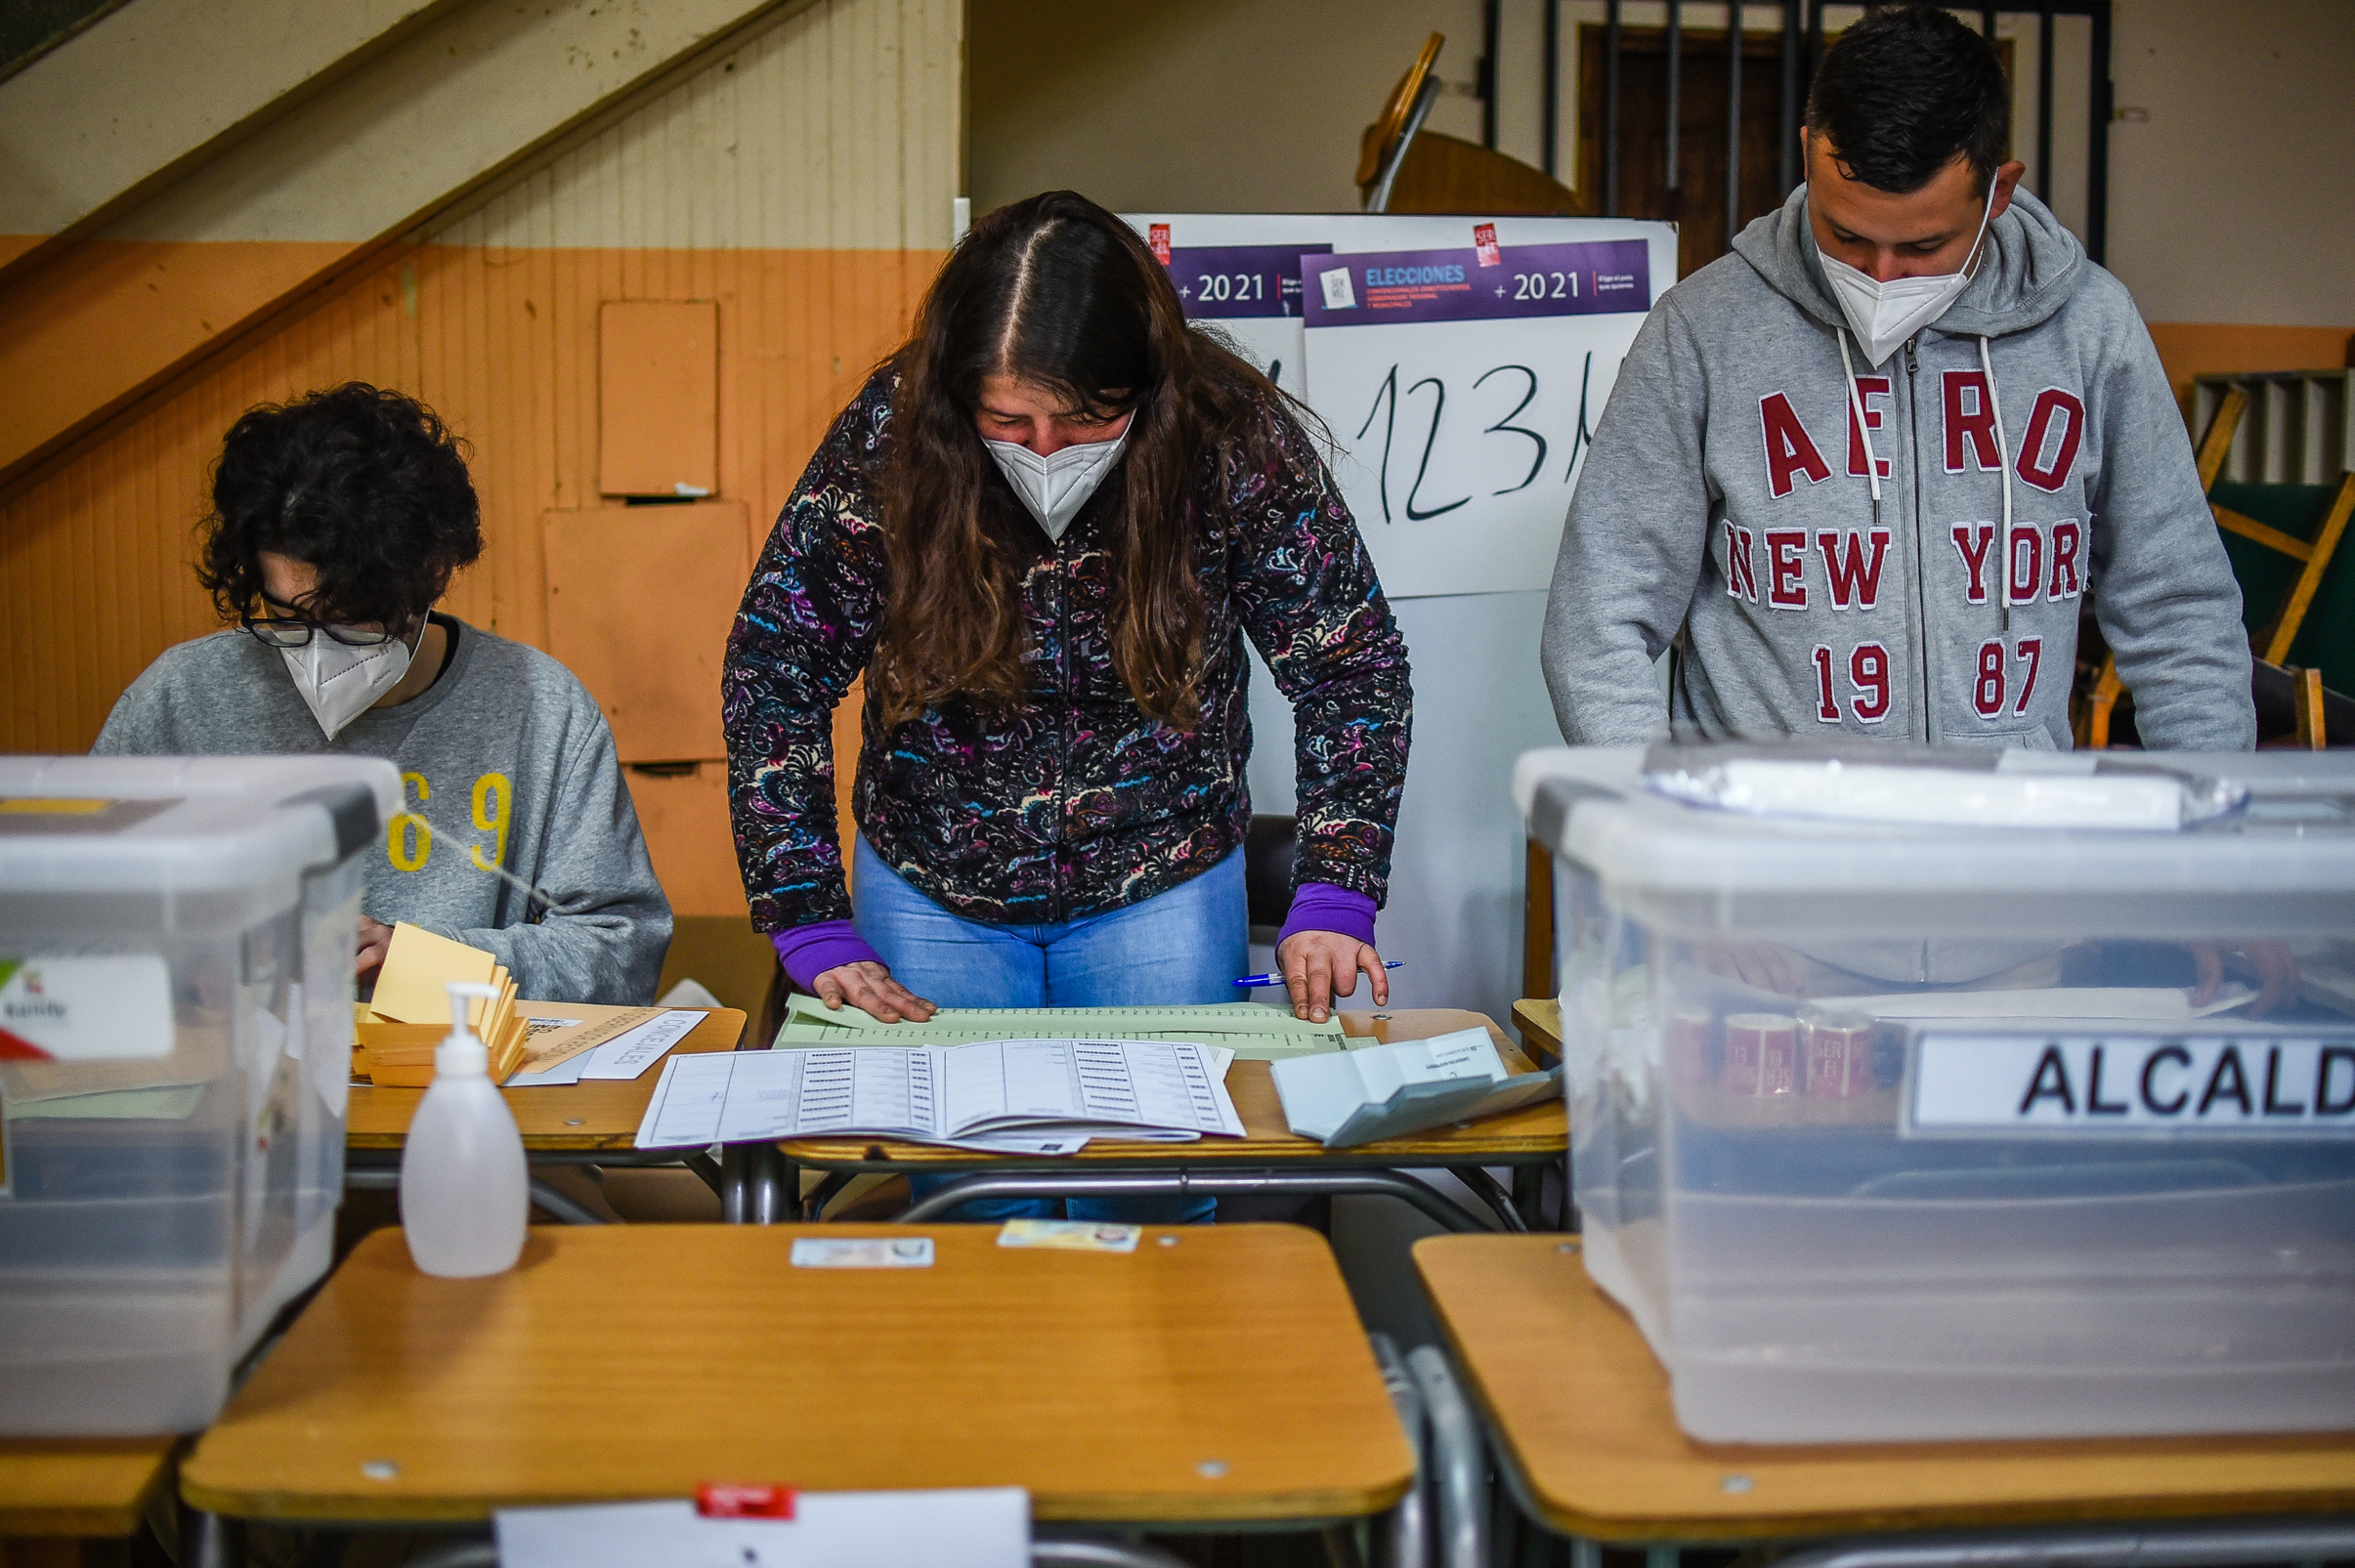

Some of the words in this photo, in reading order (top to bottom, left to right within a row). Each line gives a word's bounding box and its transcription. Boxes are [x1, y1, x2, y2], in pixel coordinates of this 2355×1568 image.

[1198, 274, 1263, 301] 2021
[1366, 265, 1465, 286] ELECCIONES
[1514, 272, 1579, 300] 2021
[1758, 369, 2086, 499] AERO
[1722, 519, 1892, 612] NEW
[1950, 518, 2094, 605] YOR
[614, 1019, 686, 1065] CONCEJALES
